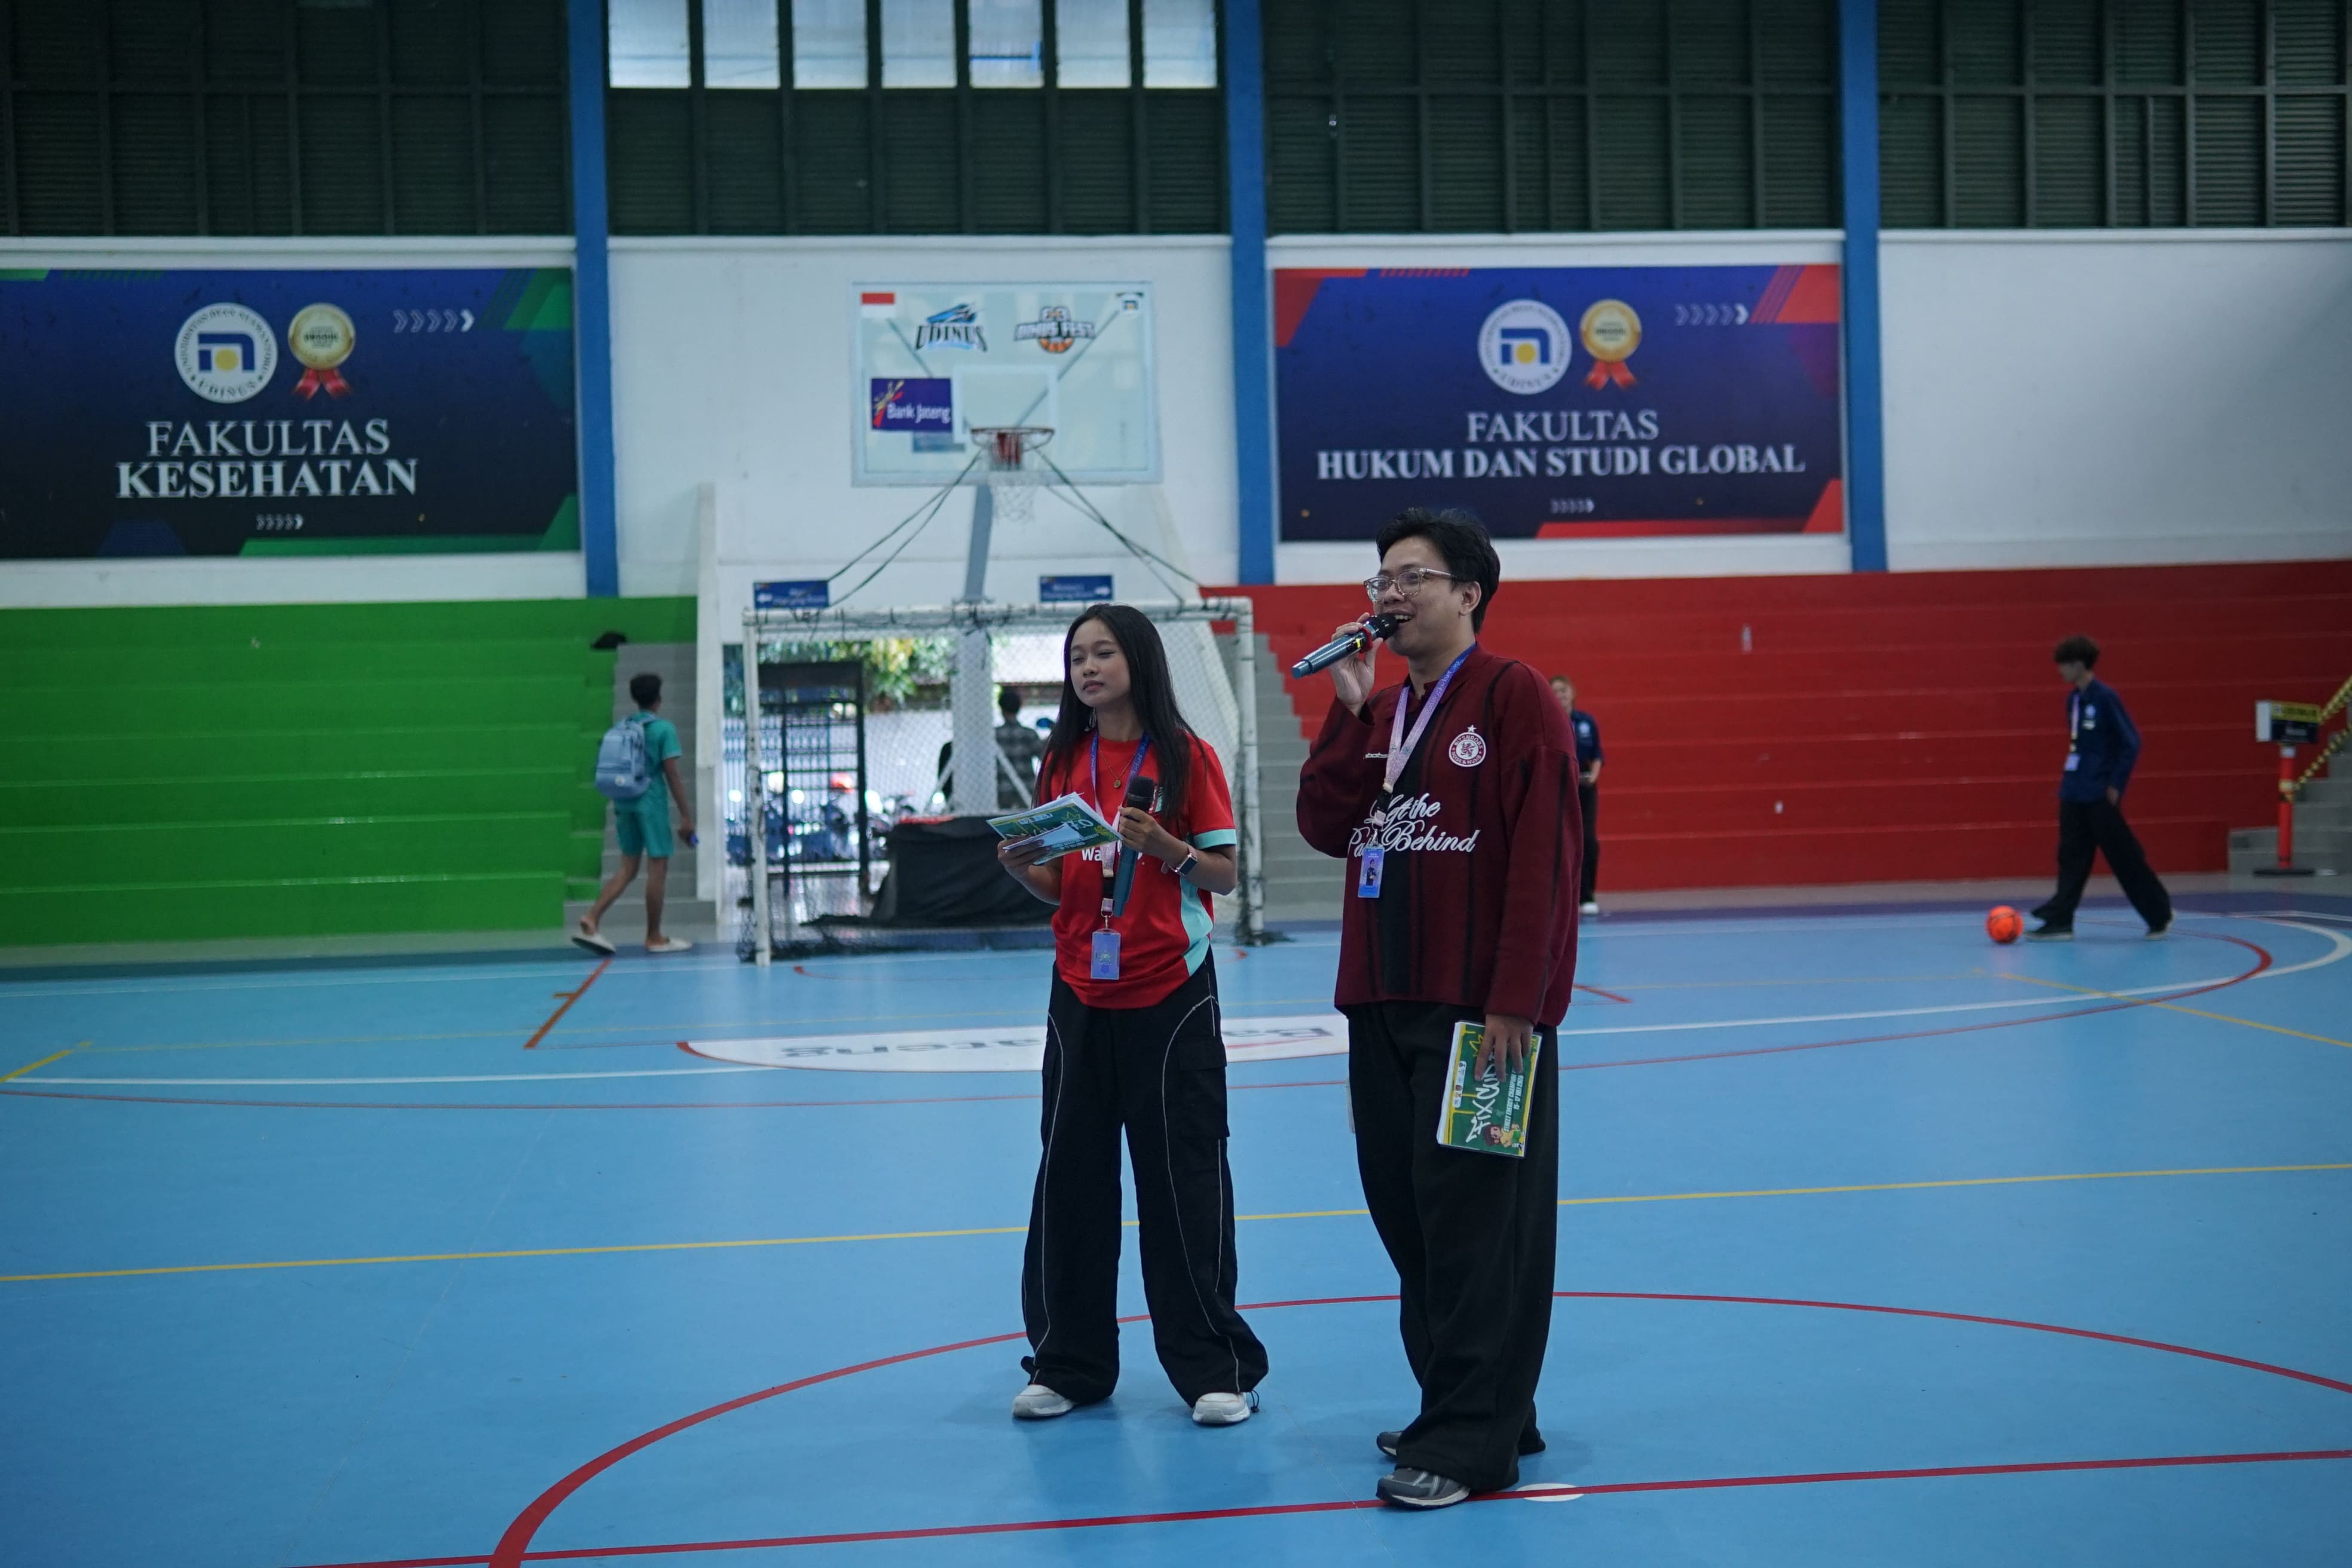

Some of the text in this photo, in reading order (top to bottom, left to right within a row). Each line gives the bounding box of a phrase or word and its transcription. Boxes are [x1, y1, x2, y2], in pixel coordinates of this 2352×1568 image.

[915, 323, 988, 353] UDINUS
[1061, 321, 1095, 338] FEST
[886, 401, 951, 424] Bank Jateng
[1466, 410, 1659, 442] FAKULTAS
[146, 419, 390, 456] FAKULTAS
[117, 459, 417, 498] KESEHATAN
[1316, 445, 1805, 480] HUKUM DAN STUDI GLOBAL
[1381, 819, 1481, 853] Behind
